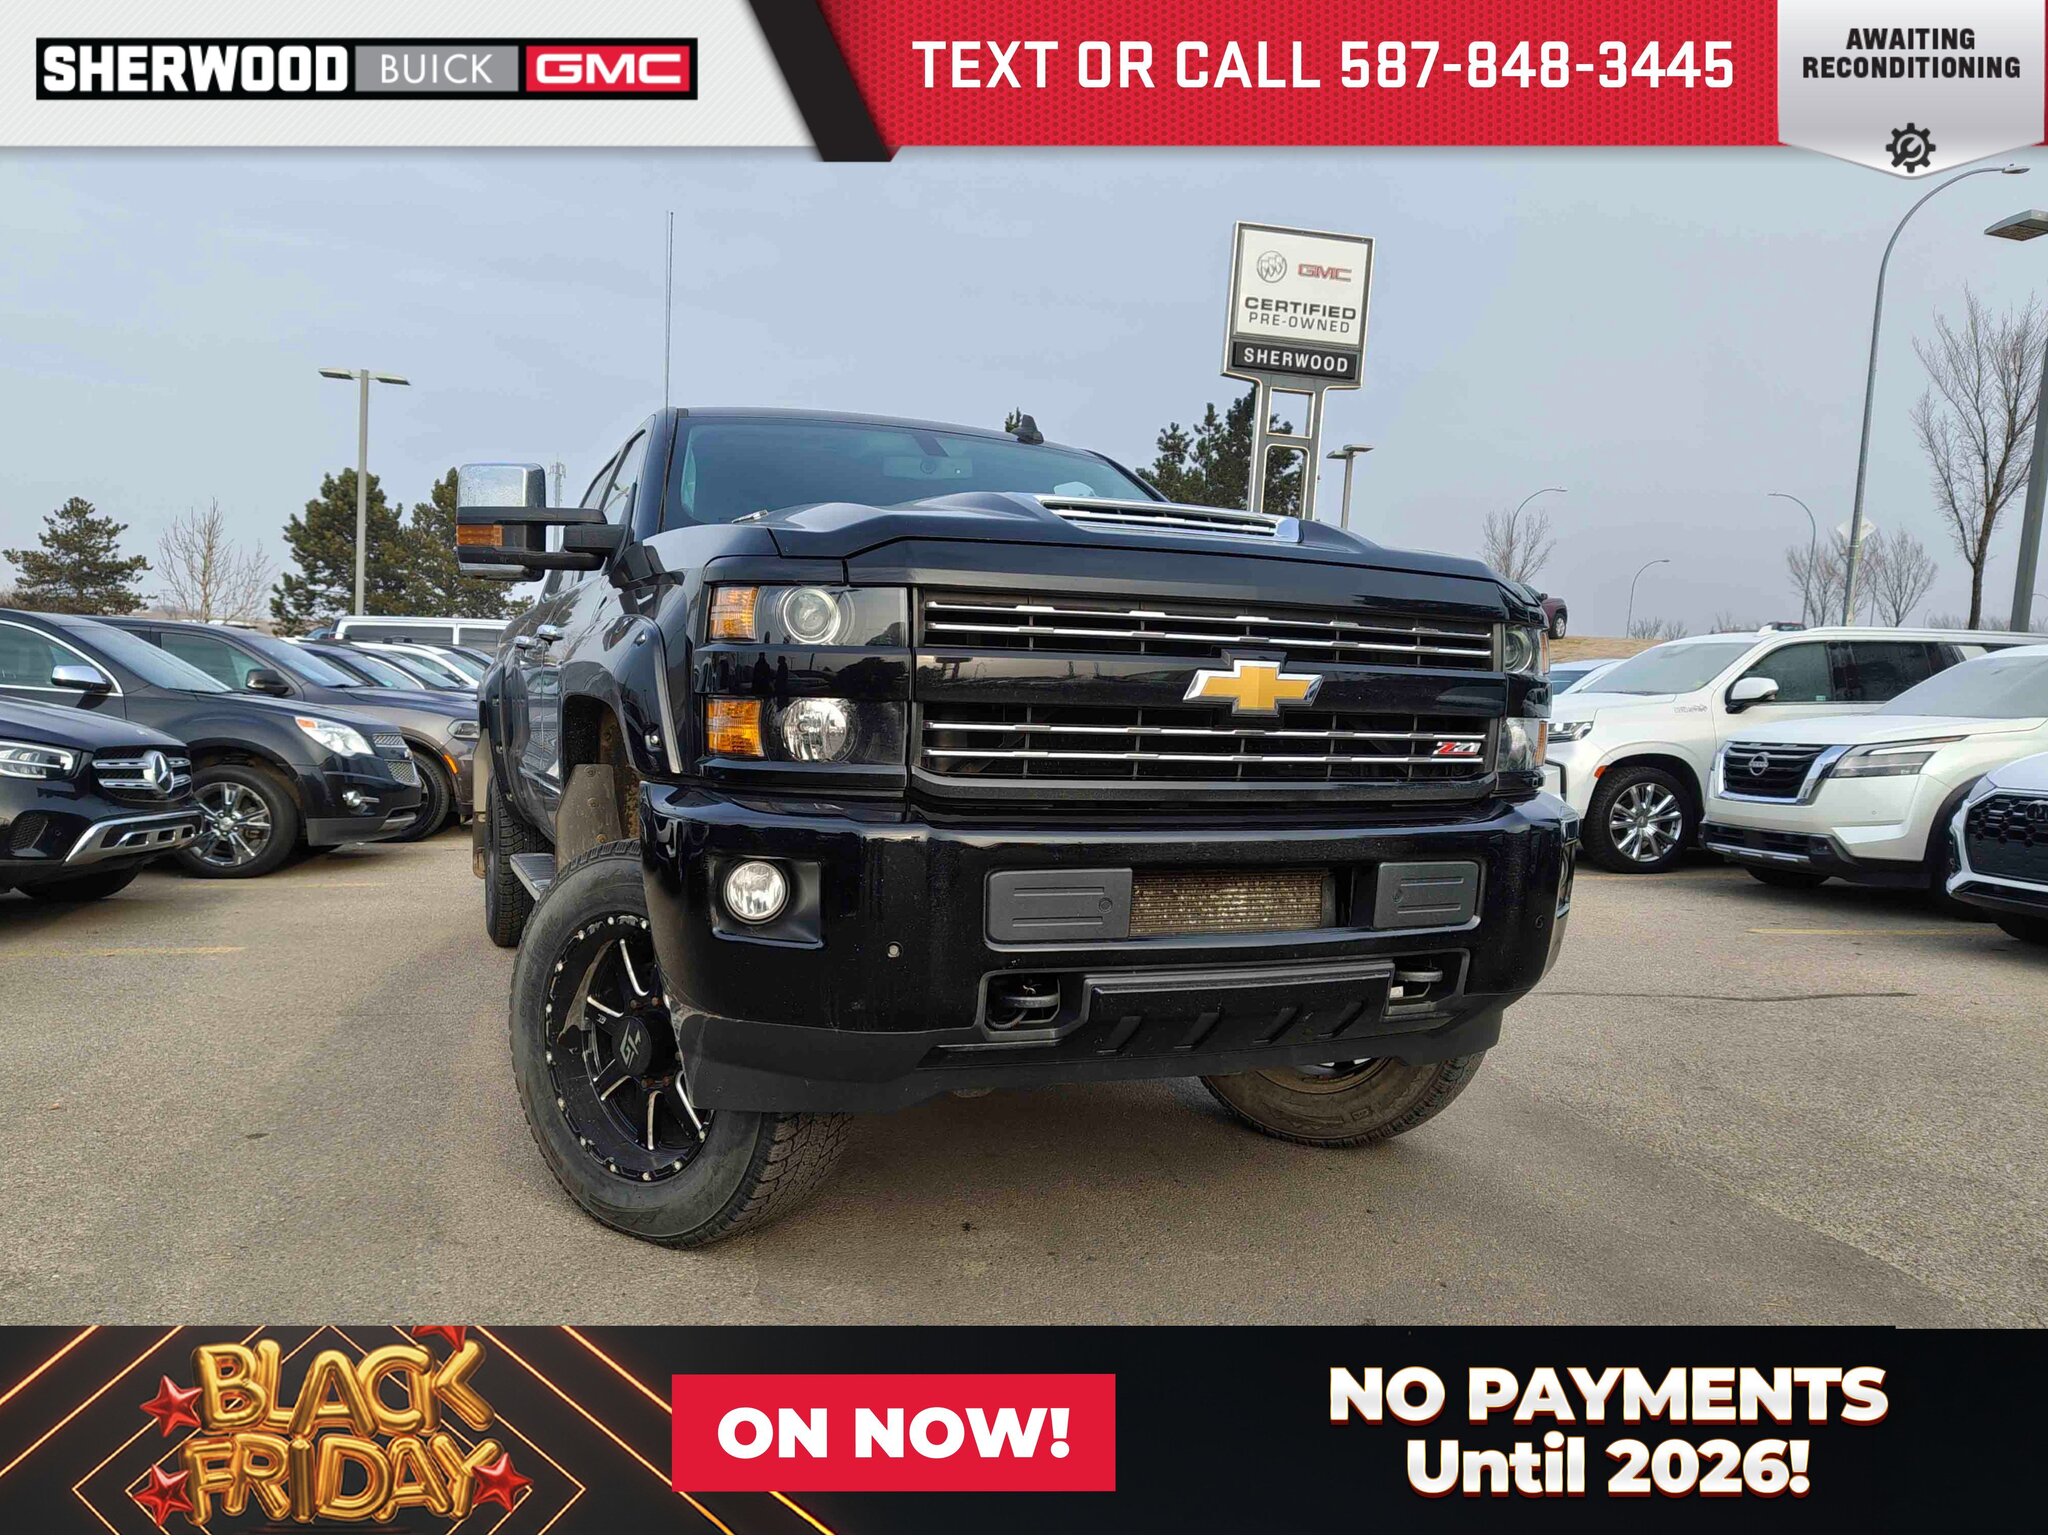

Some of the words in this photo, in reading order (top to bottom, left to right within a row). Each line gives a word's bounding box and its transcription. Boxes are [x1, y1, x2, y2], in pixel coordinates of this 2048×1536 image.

[1298, 264, 1352, 282] GMC
[1245, 297, 1357, 320] CERTIFIED
[1249, 312, 1350, 333] PRE-OWNED
[1244, 348, 1348, 372] SHERWOOD
